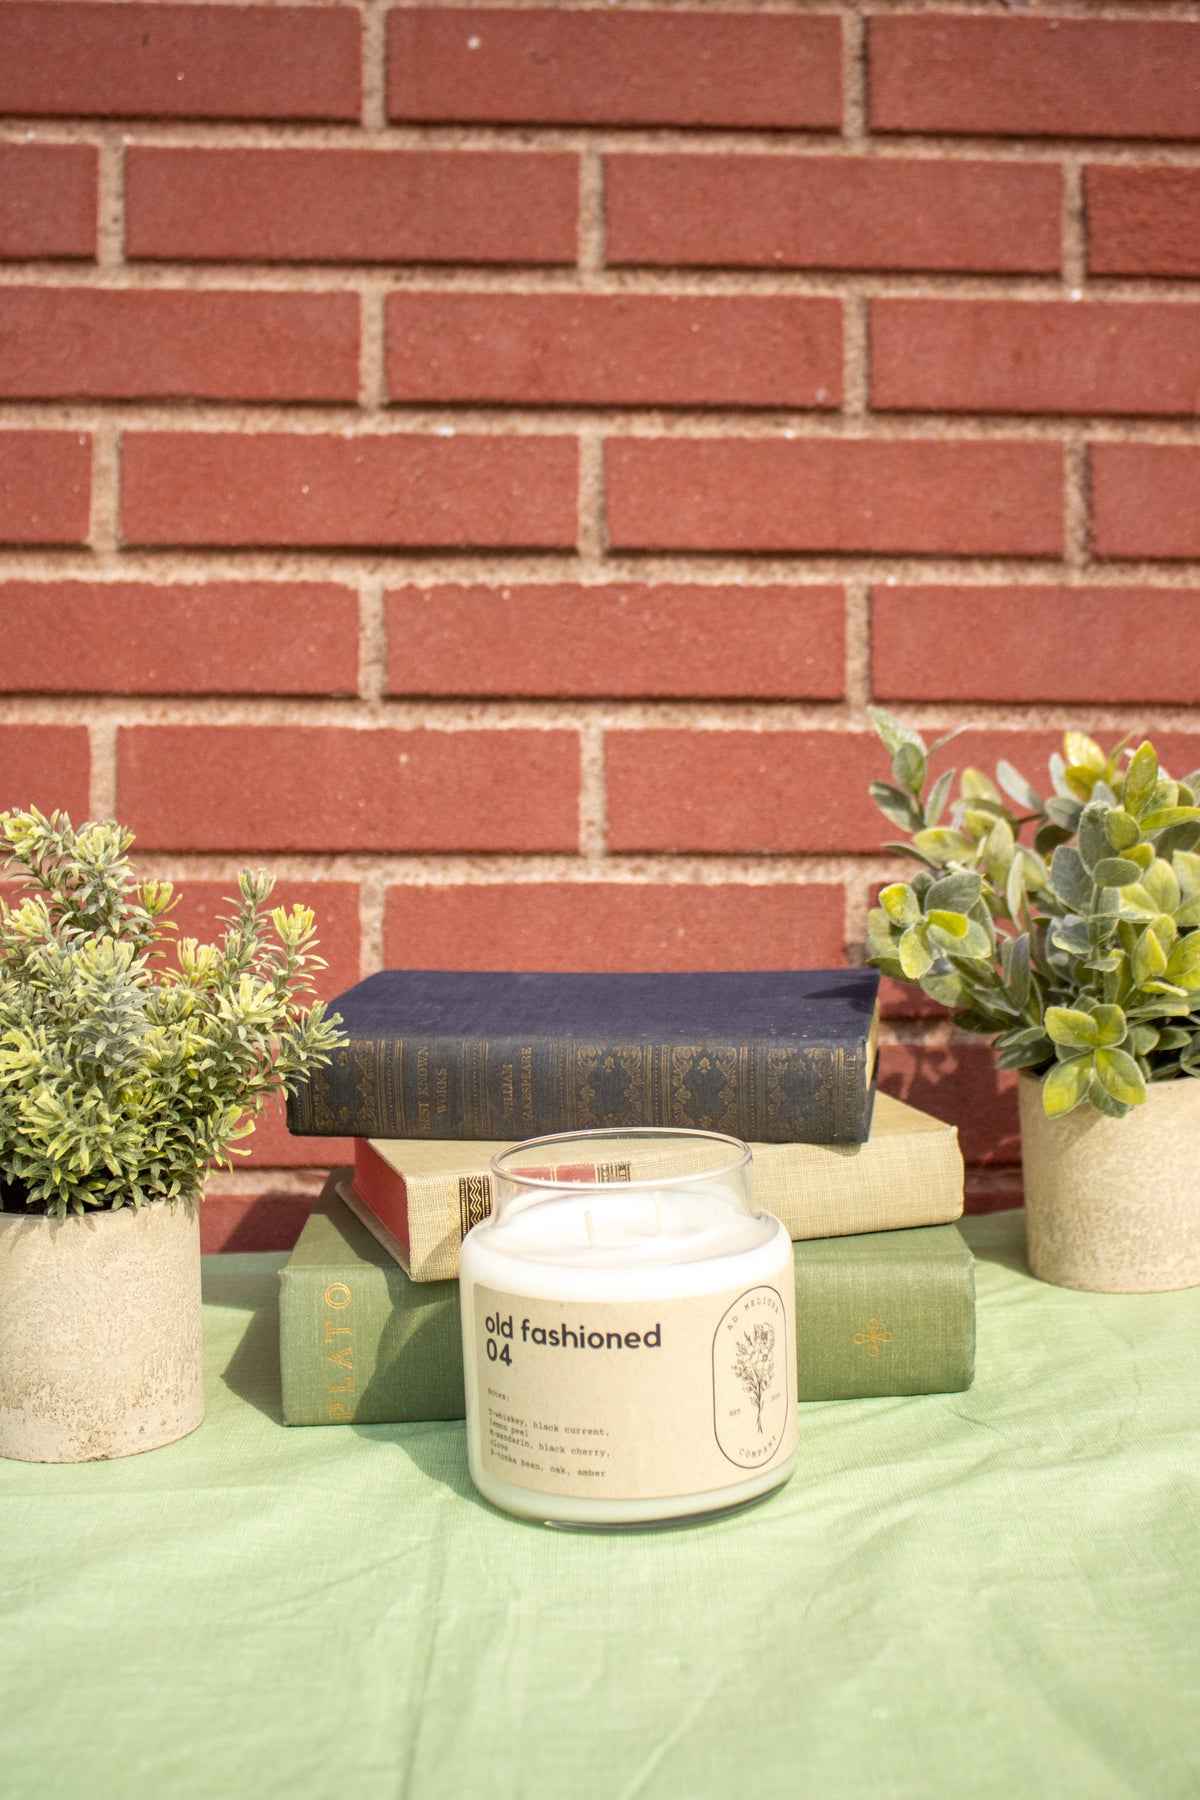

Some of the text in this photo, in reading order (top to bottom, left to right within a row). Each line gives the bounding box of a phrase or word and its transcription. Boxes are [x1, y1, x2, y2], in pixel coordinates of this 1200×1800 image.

[417, 1045, 430, 1096] KNOWN
[435, 1068, 448, 1113] WORKS
[485, 1312, 662, 1350] old fashioned
[726, 1315, 739, 1331] AD
[324, 1282, 356, 1420] PLATO
[486, 1338, 513, 1366] 04
[487, 1387, 510, 1401] Notes:
[489, 1419, 529, 1437] lemon peel
[533, 1421, 559, 1432] black
[564, 1426, 610, 1437] current,
[489, 1439, 509, 1451] clove
[538, 1442, 566, 1454] black
[570, 1448, 611, 1458] cherry,
[739, 1434, 777, 1458] COMPANY
[521, 1459, 544, 1472] bean,
[550, 1466, 571, 1476] oak,
[577, 1469, 607, 1478] amber
